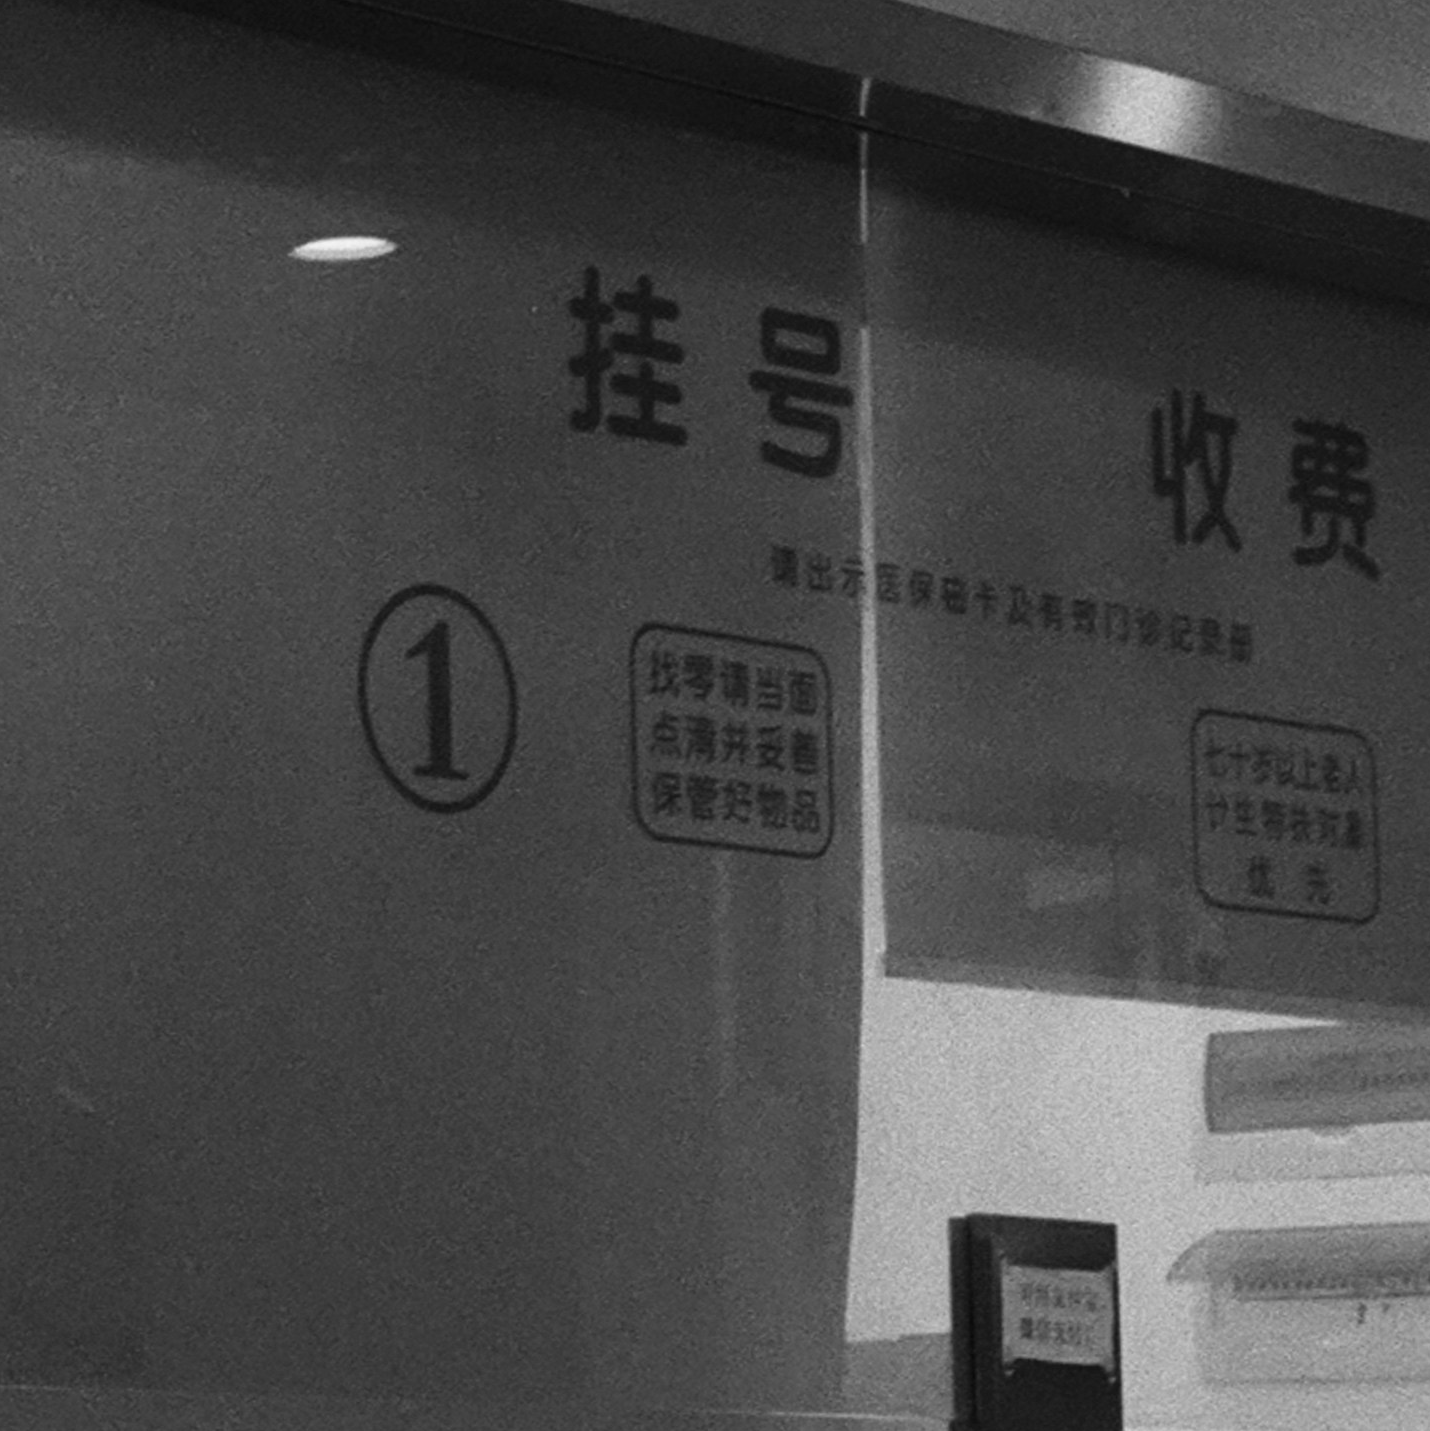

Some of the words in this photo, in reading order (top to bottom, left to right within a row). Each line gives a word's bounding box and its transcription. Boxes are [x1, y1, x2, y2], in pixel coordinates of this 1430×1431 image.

[567, 265, 855, 479] 挂号
[1149, 386, 1382, 582] 收费
[648, 649, 816, 715] 找零请当面
[649, 709, 819, 776] 点清并妥善
[1203, 738, 1362, 795] 七十岁以上老人
[651, 771, 821, 835] 保管好物品
